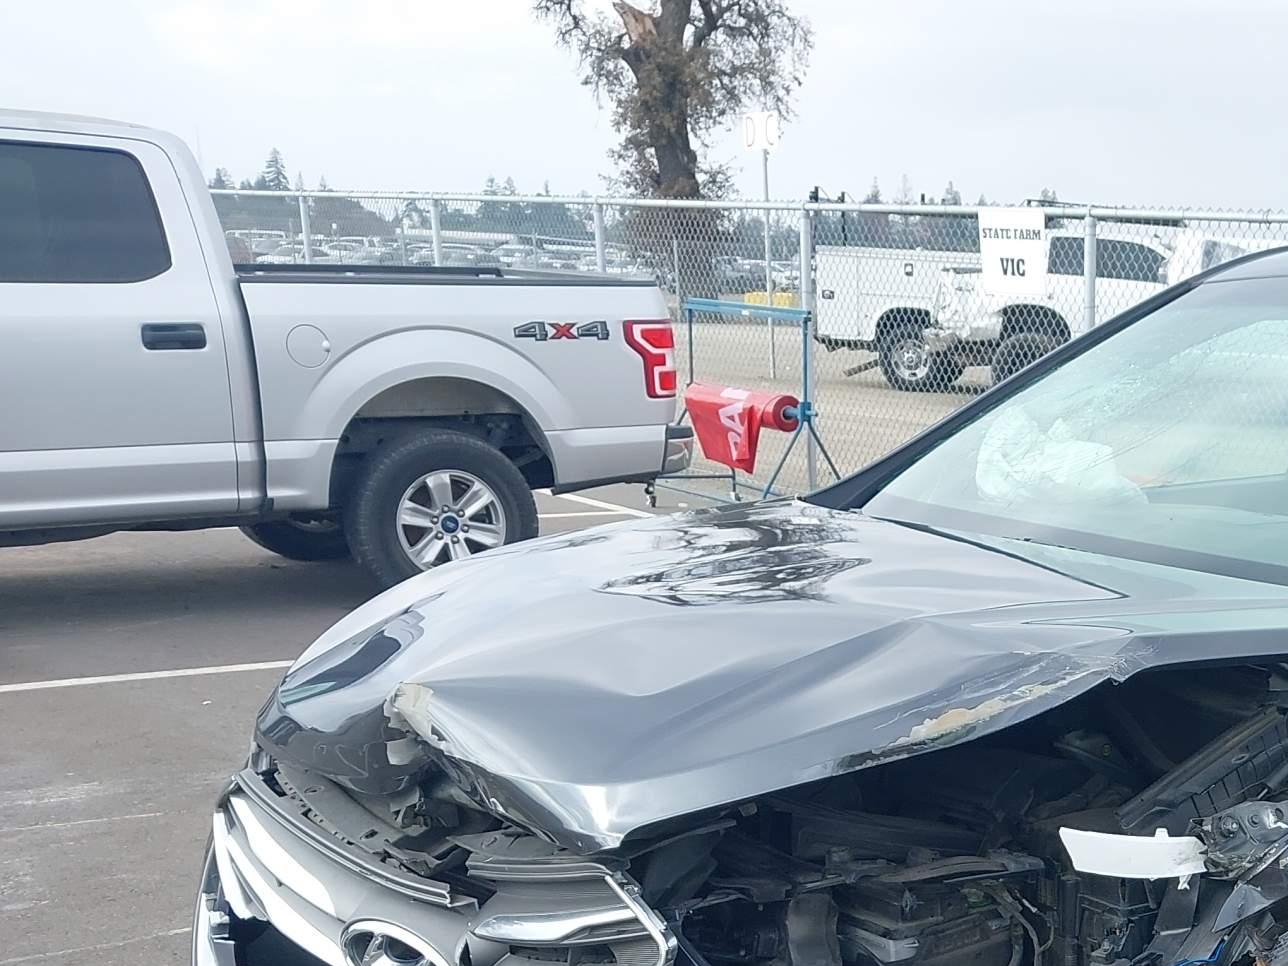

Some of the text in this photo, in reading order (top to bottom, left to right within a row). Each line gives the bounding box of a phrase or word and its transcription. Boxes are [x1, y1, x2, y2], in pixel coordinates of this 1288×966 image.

[982, 227, 1041, 241] STATE FARM
[1000, 257, 1026, 277] VIC
